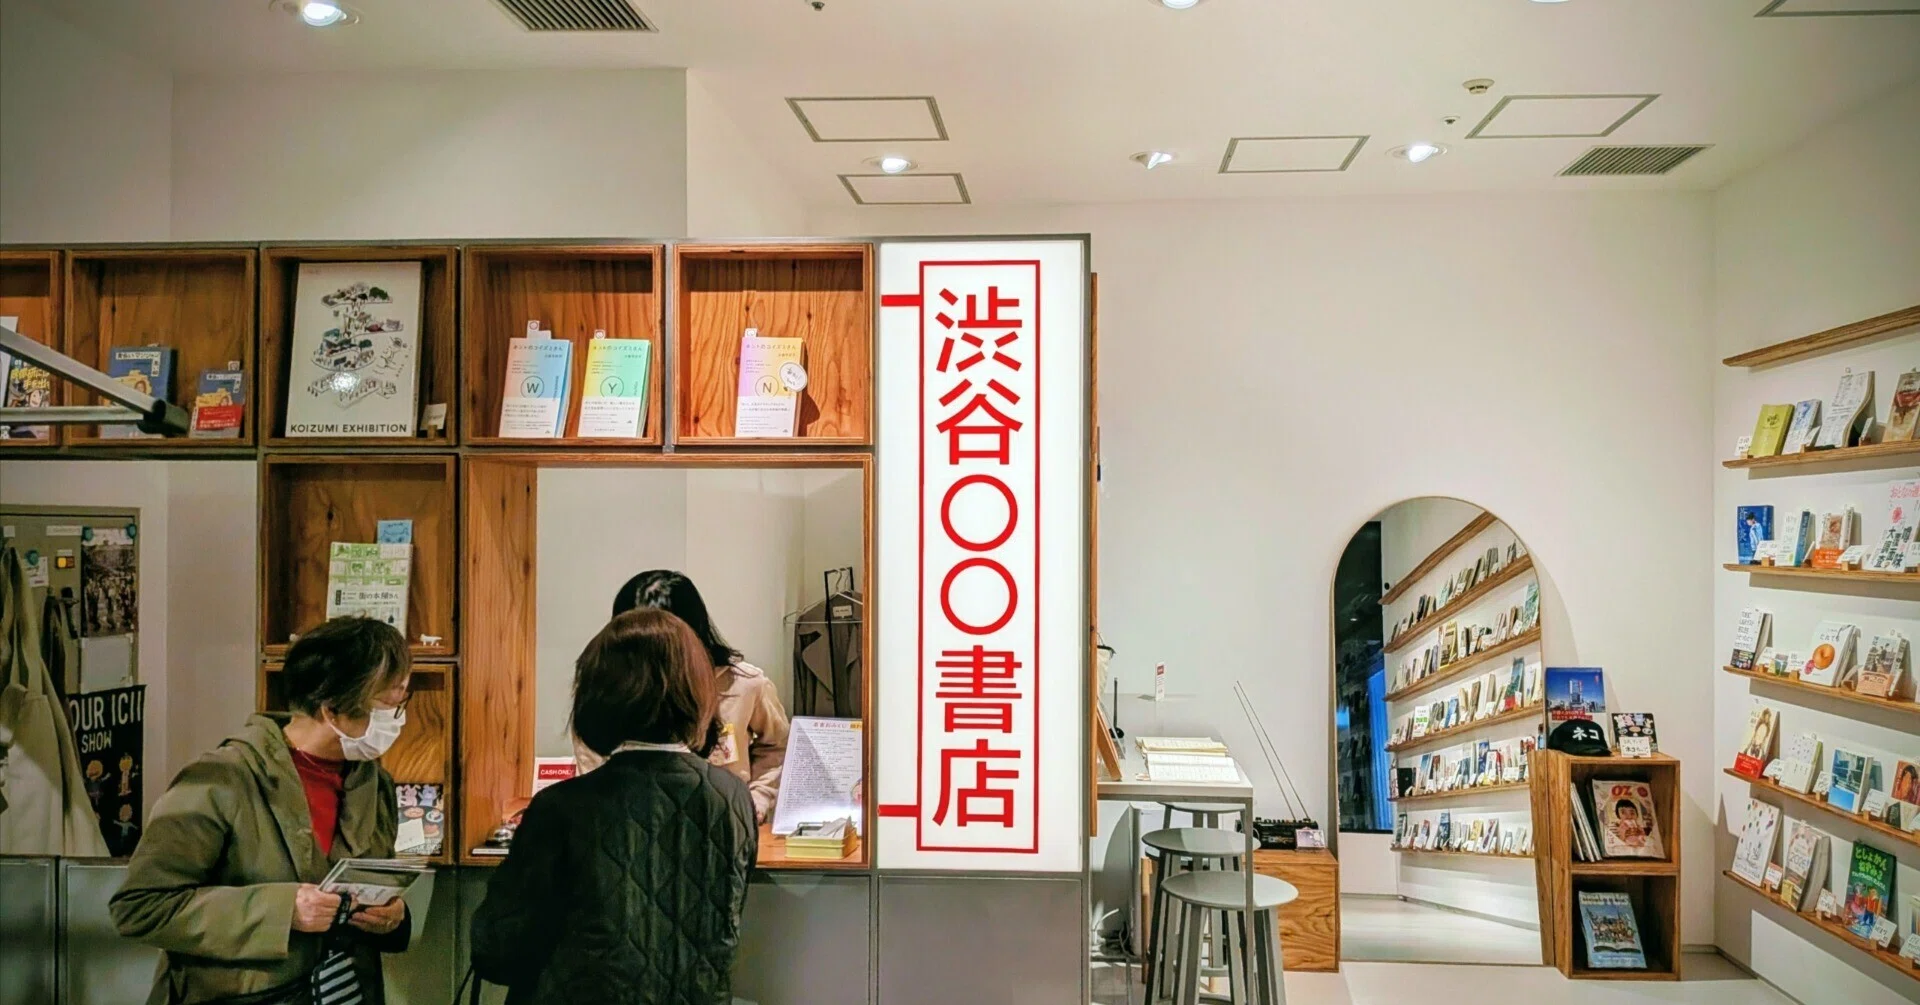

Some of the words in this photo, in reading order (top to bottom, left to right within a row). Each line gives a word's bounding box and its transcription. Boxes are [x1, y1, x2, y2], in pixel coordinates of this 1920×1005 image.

[526, 382, 540, 394] W
[608, 383, 618, 394] Y
[762, 382, 772, 393] N
[290, 424, 339, 433] KOIZUMI
[342, 424, 407, 433] EXHIBITION
[1572, 726, 1600, 741] ネコ
[81, 730, 112, 754] SHOW
[1611, 784, 1633, 798] OZ
